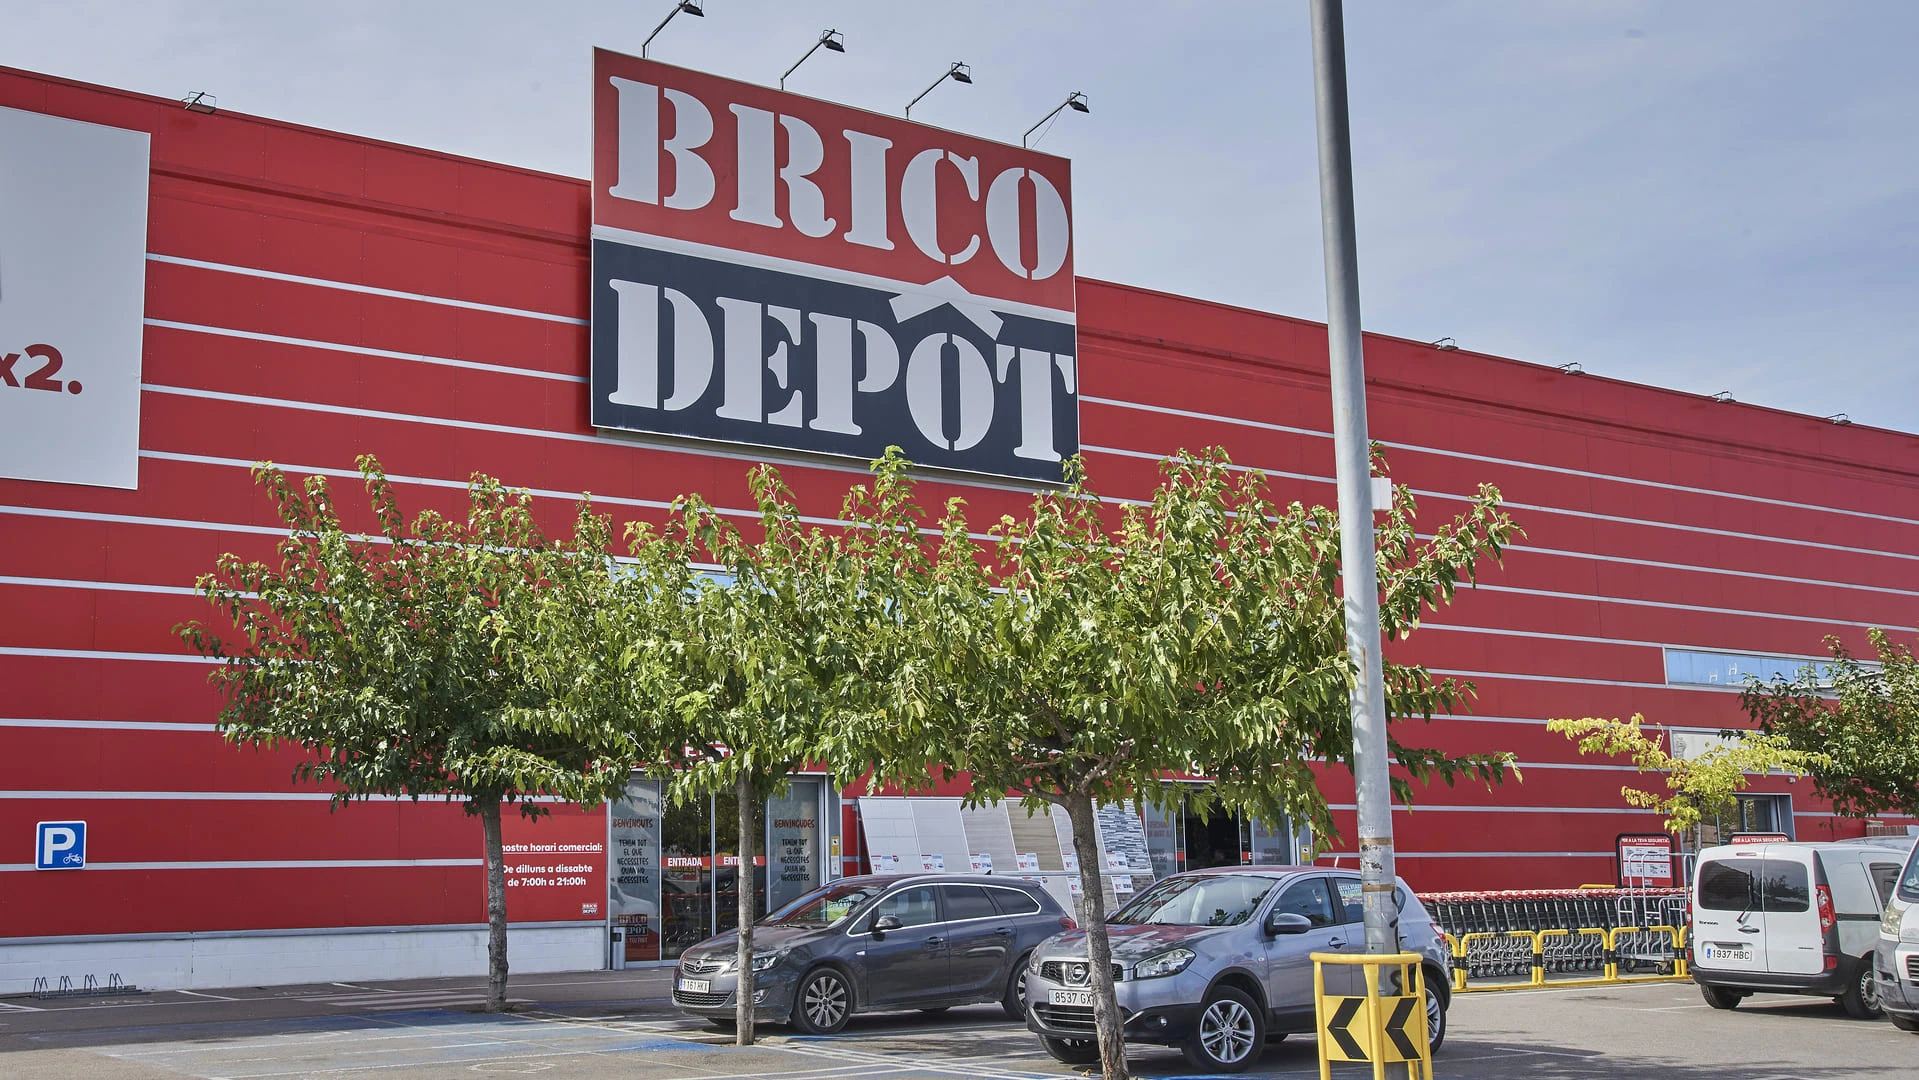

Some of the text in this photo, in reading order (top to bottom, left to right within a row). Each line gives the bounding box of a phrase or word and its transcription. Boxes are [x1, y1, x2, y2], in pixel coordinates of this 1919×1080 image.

[608, 75, 1069, 280] BRICO
[0, 343, 83, 395] x2.
[613, 818, 653, 828] BENVINGUTS
[774, 819, 815, 829] BENVINGUDES
[43, 827, 76, 864] P
[530, 843, 556, 851] horari
[558, 842, 602, 851] comercial:
[623, 848, 642, 856] EL QUE
[617, 857, 649, 866] NECESSITES
[667, 857, 703, 867] ENTRADA
[723, 857, 757, 865] ENTA
[780, 856, 810, 864] NECESSITES
[503, 865, 514, 873] De
[516, 864, 546, 873] dilluns
[555, 864, 593, 873] dissabte
[507, 878, 519, 887] de
[521, 877, 547, 886] 7:00h
[556, 876, 586, 886] 21:00h
[617, 875, 649, 884] NECESSITES
[780, 873, 810, 882] NECESSITES
[625, 924, 648, 934] EPÔT
[1712, 949, 1750, 960] 1937 HBC
[1055, 992, 1093, 1005] 8537 GX
